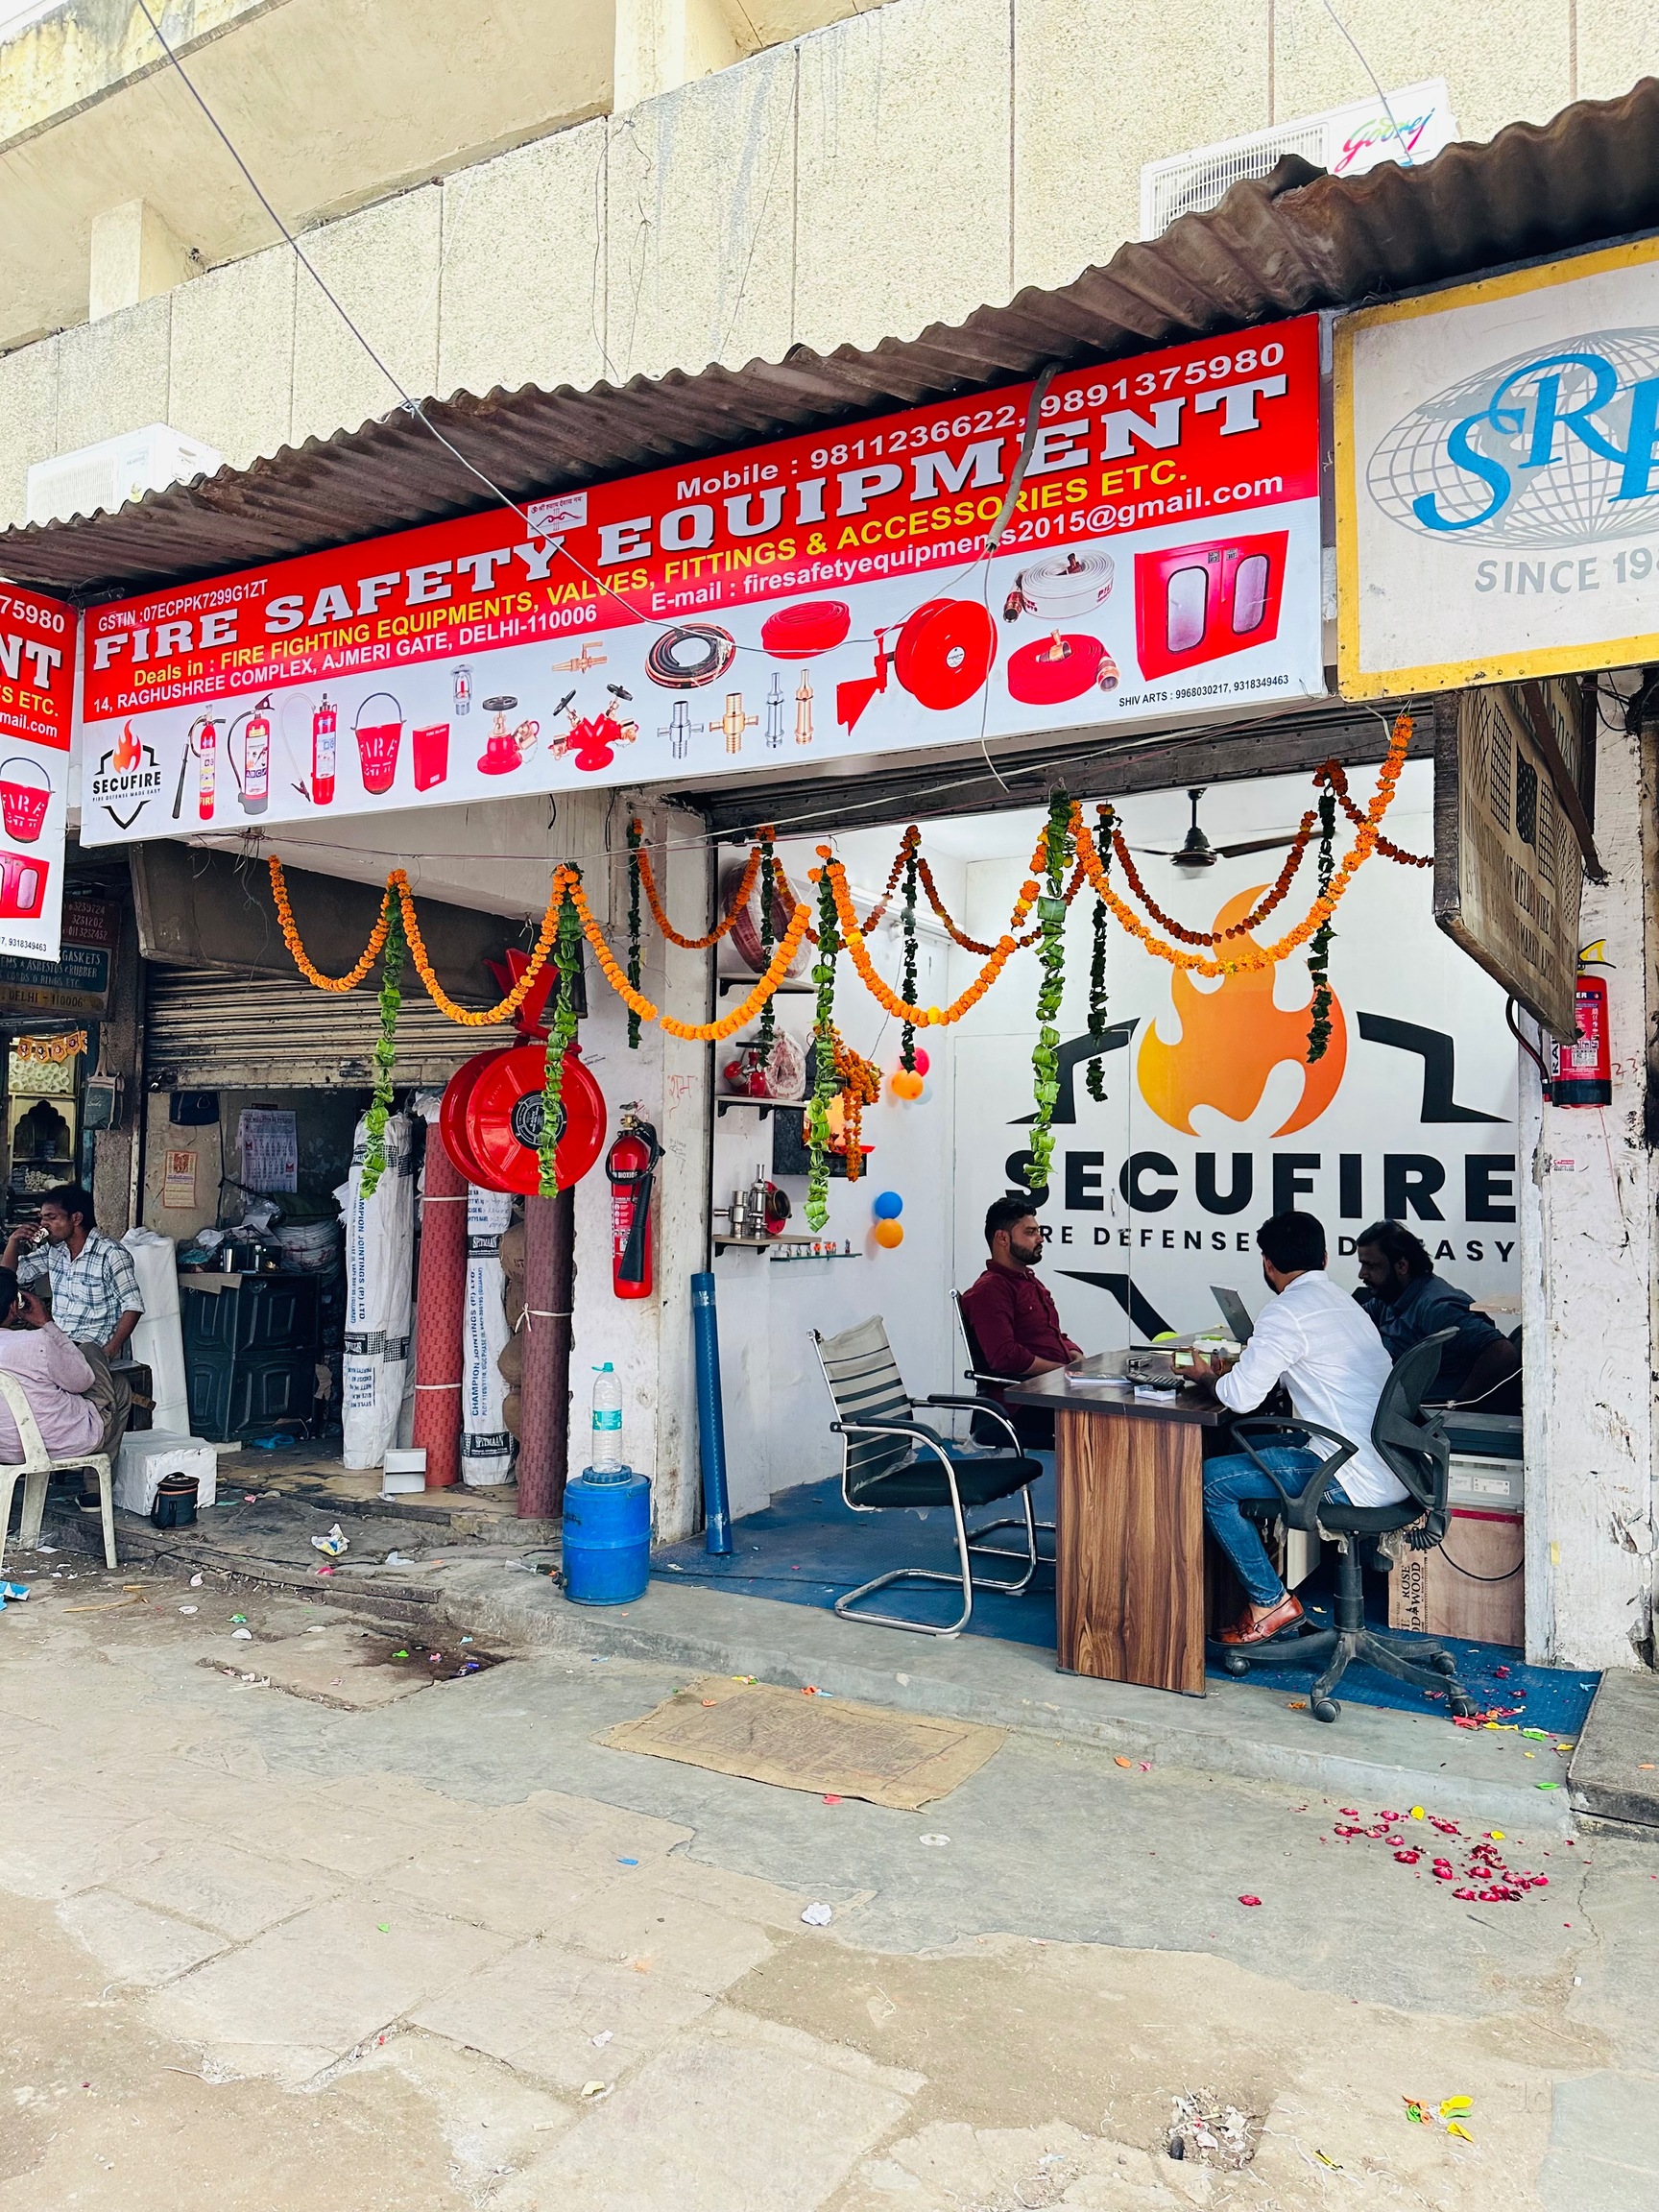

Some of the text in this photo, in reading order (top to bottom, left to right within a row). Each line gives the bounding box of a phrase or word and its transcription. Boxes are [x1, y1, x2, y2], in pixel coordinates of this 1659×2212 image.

[1334, 107, 1435, 173] Godrej
[677, 463, 779, 500] Mobile
[809, 404, 1026, 469] 9811236622,
[1040, 342, 1285, 418] 9891375980
[93, 373, 1287, 671] FIRE SAFETY EQUIPMENT
[652, 580, 722, 612] E-mail
[743, 475, 1283, 594] firesafetyequipmens2015@gmail.com
[133, 664, 181, 687] Deals
[187, 660, 204, 675] in
[221, 644, 265, 670] FIRE
[271, 624, 371, 661] FIGHTING
[377, 591, 540, 639] EQUIPMENTS,
[546, 567, 656, 606] VALVES,
[664, 538, 797, 584] FITTINGS
[805, 531, 829, 555] &
[836, 477, 1089, 550] ACCESSORIES
[1101, 459, 1187, 497] ETC.
[1475, 546, 1659, 595] SINCE 19
[98, 610, 135, 632] GSTIN
[93, 604, 597, 713] 14, RAGHUSHREE COMPLEX, AJMERI GATE, DELHI-110006
[18, 690, 59, 717] ETC.
[1118, 695, 1142, 708] SHIV
[1142, 691, 1168, 705] ARTS
[1175, 683, 1232, 700] 9968030217,
[1233, 674, 1289, 692] 9318349463
[92, 770, 162, 795] SECUFIRE
[8, 939, 47, 952] 9318349463
[26, 959, 63, 974] ASBESTOS
[68, 965, 98, 978] RUBBER
[9, 989, 38, 1004] DELHI
[52, 995, 84, 1008] 110006
[1005, 1149, 1517, 1223] SECUFIRE
[1039, 1225, 1516, 1262] RE DEFENSE ASY
[469, 1310, 480, 1360] JOINTINGS
[471, 1362, 480, 1416] CHAMPION
[1401, 1565, 1410, 1599] ROSE
[1410, 1561, 1421, 1605] WOOD
